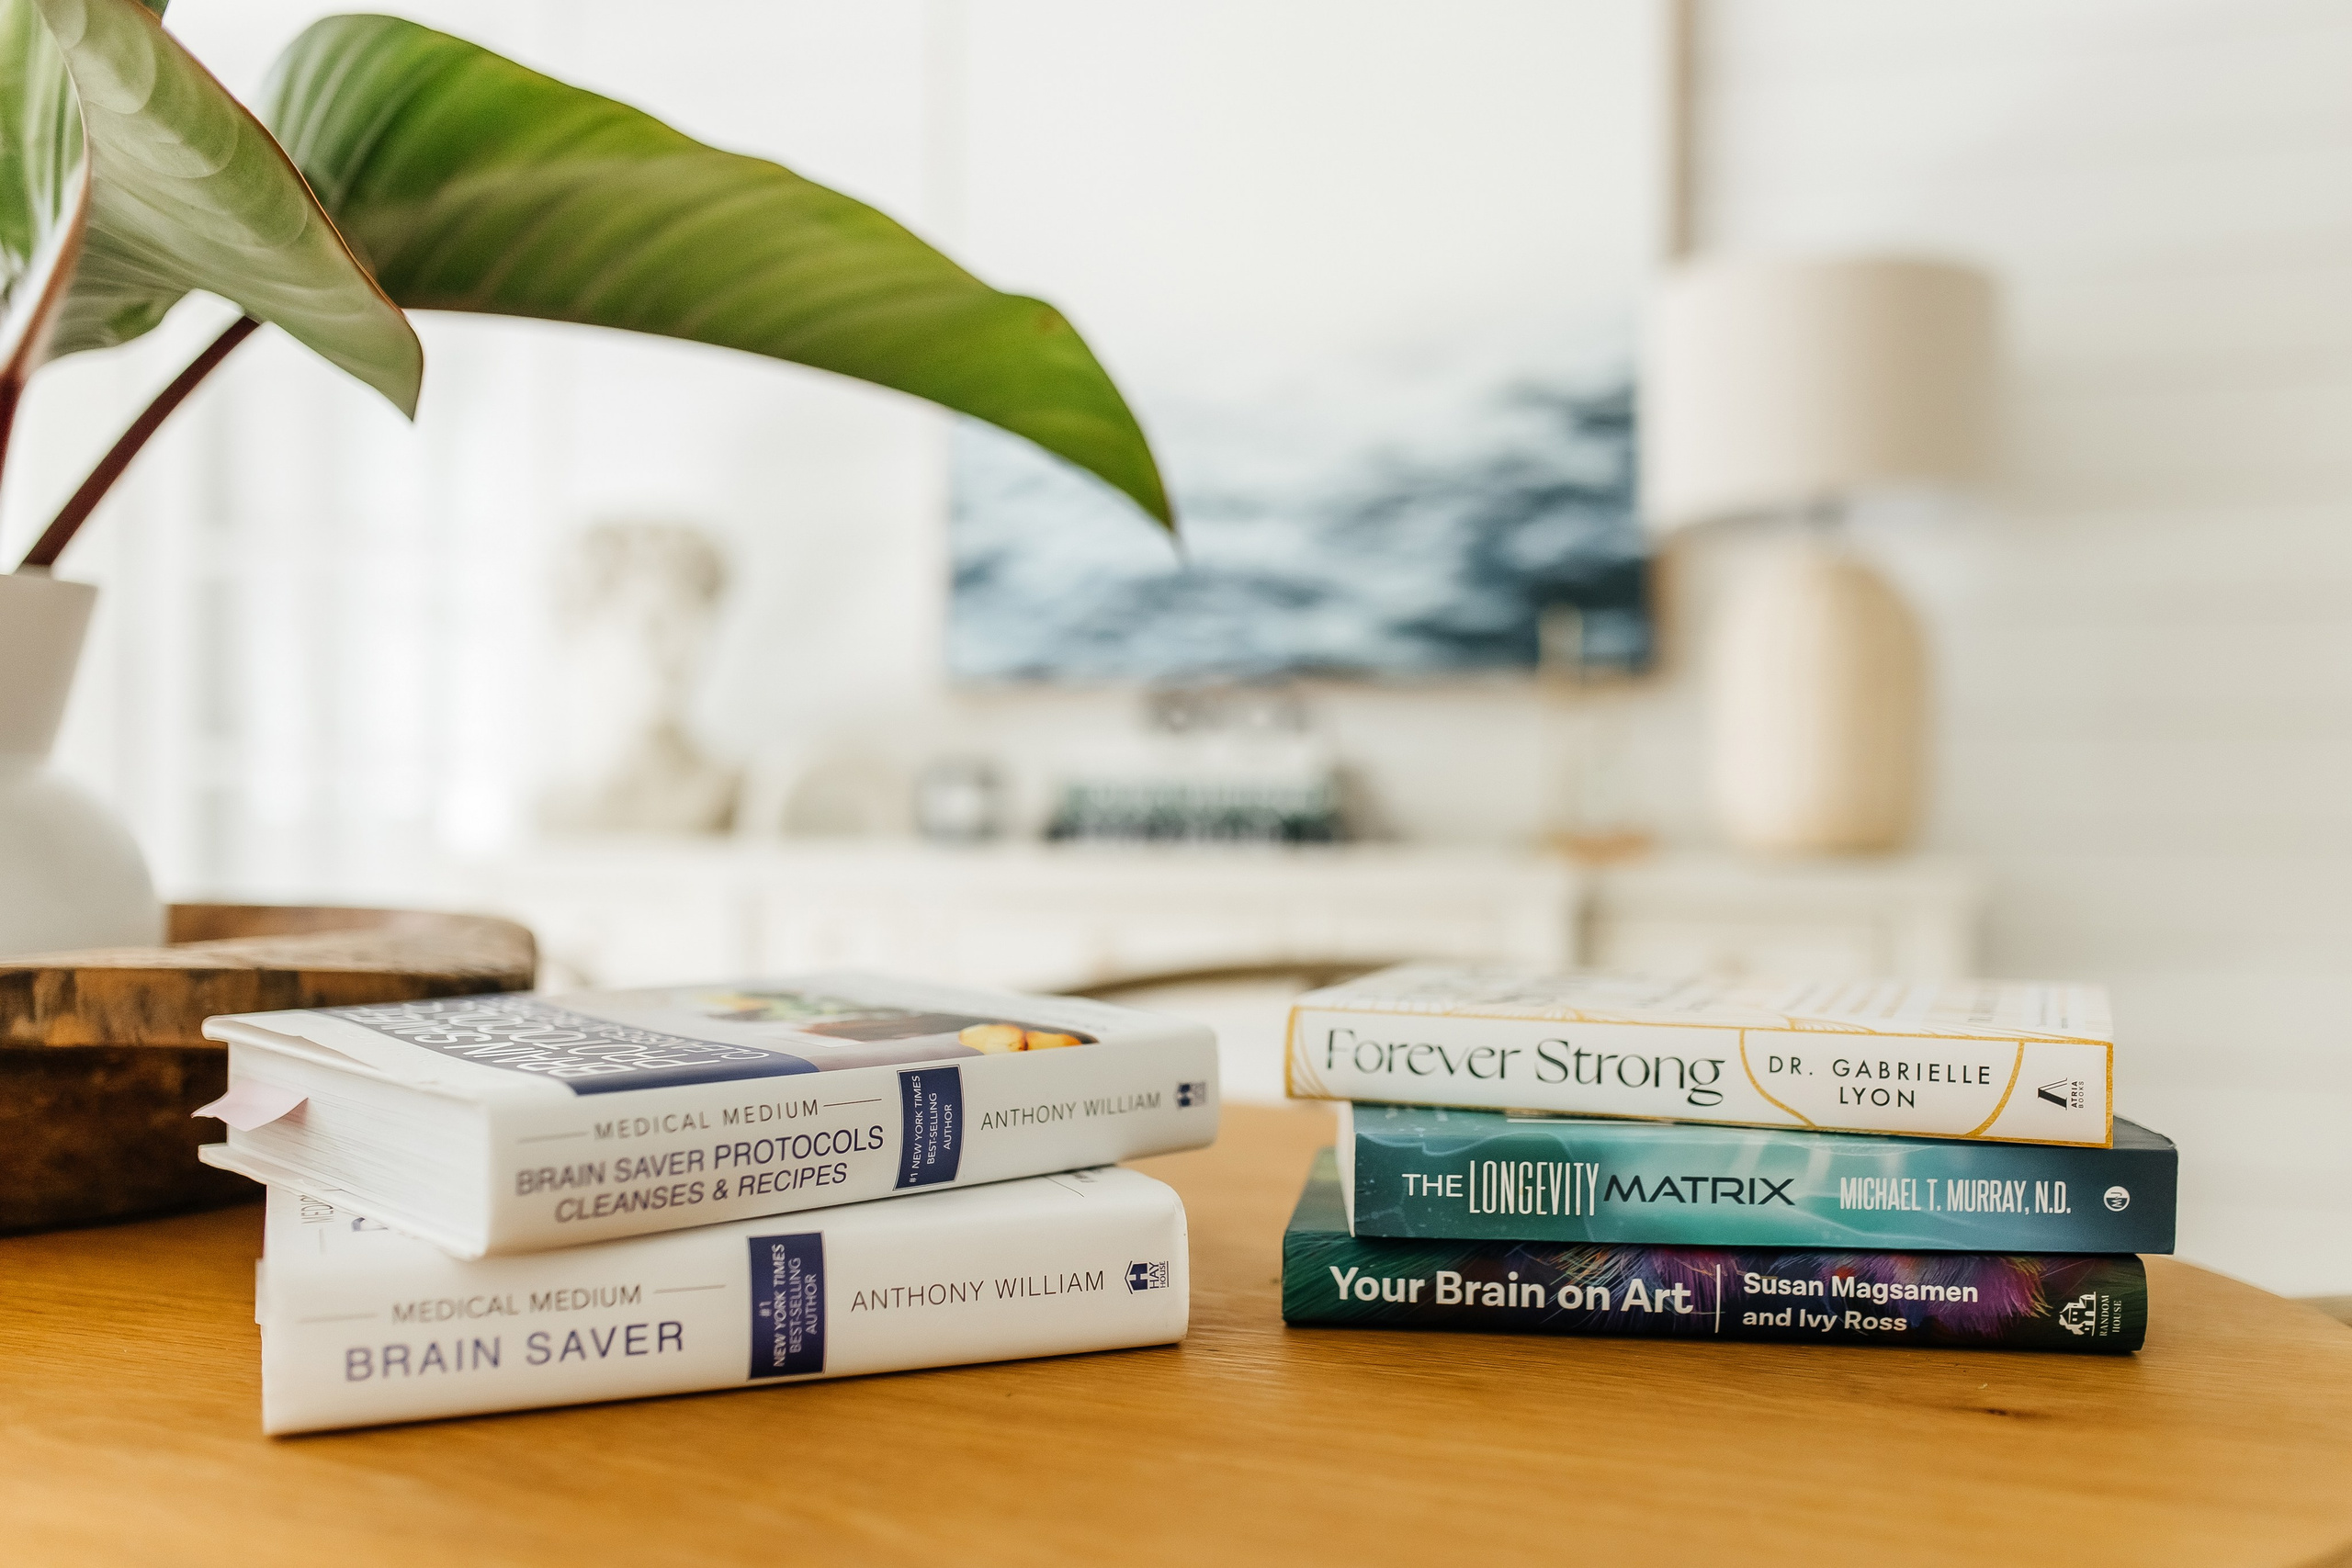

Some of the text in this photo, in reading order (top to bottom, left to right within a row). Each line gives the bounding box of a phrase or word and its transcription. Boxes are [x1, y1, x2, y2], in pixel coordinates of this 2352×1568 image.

[1326, 1028, 1725, 1107] Forever Strong
[1769, 1055, 1992, 1086] DR. GABRIELLE
[979, 1102, 1077, 1131] ANTHONY
[1083, 1092, 1161, 1117] WILLIAM
[1839, 1086, 1917, 1110] LYON
[594, 1099, 820, 1141] MEDICAL MEDIUM
[909, 1075, 923, 1183] #1 NEW YORK TIMES
[926, 1092, 938, 1165] BEST-SELLING
[943, 1103, 953, 1150] AUTHOR
[515, 1124, 884, 1196] BRAIN SAVER PROTOCOLS
[554, 1162, 848, 1224] CLEANSES & RECIPES
[1402, 1160, 1796, 1216] THE LONGEVITY MATRIX
[1839, 1177, 2072, 1214] MICHAEL T. MURRAY, N.D.
[851, 1270, 1104, 1313] ANTHONY WILLIAM
[1148, 1261, 1159, 1290] HAY
[1329, 1266, 1694, 1314] Your Brain on Art
[1743, 1272, 1979, 1305] Susan Magsamen
[390, 1284, 643, 1325] MEDICAL MEDIUM
[759, 1301, 772, 1317] #1
[772, 1243, 786, 1367] NEW YORK TIMES
[788, 1257, 802, 1353] BEST-SELLING
[805, 1273, 818, 1336] AUTHOR
[1742, 1308, 1908, 1333] and Ivy Ross
[2099, 1294, 2109, 1337] RANDOM
[2111, 1300, 2122, 1333] HOUSE
[345, 1320, 685, 1382] BRAIN SAVER
